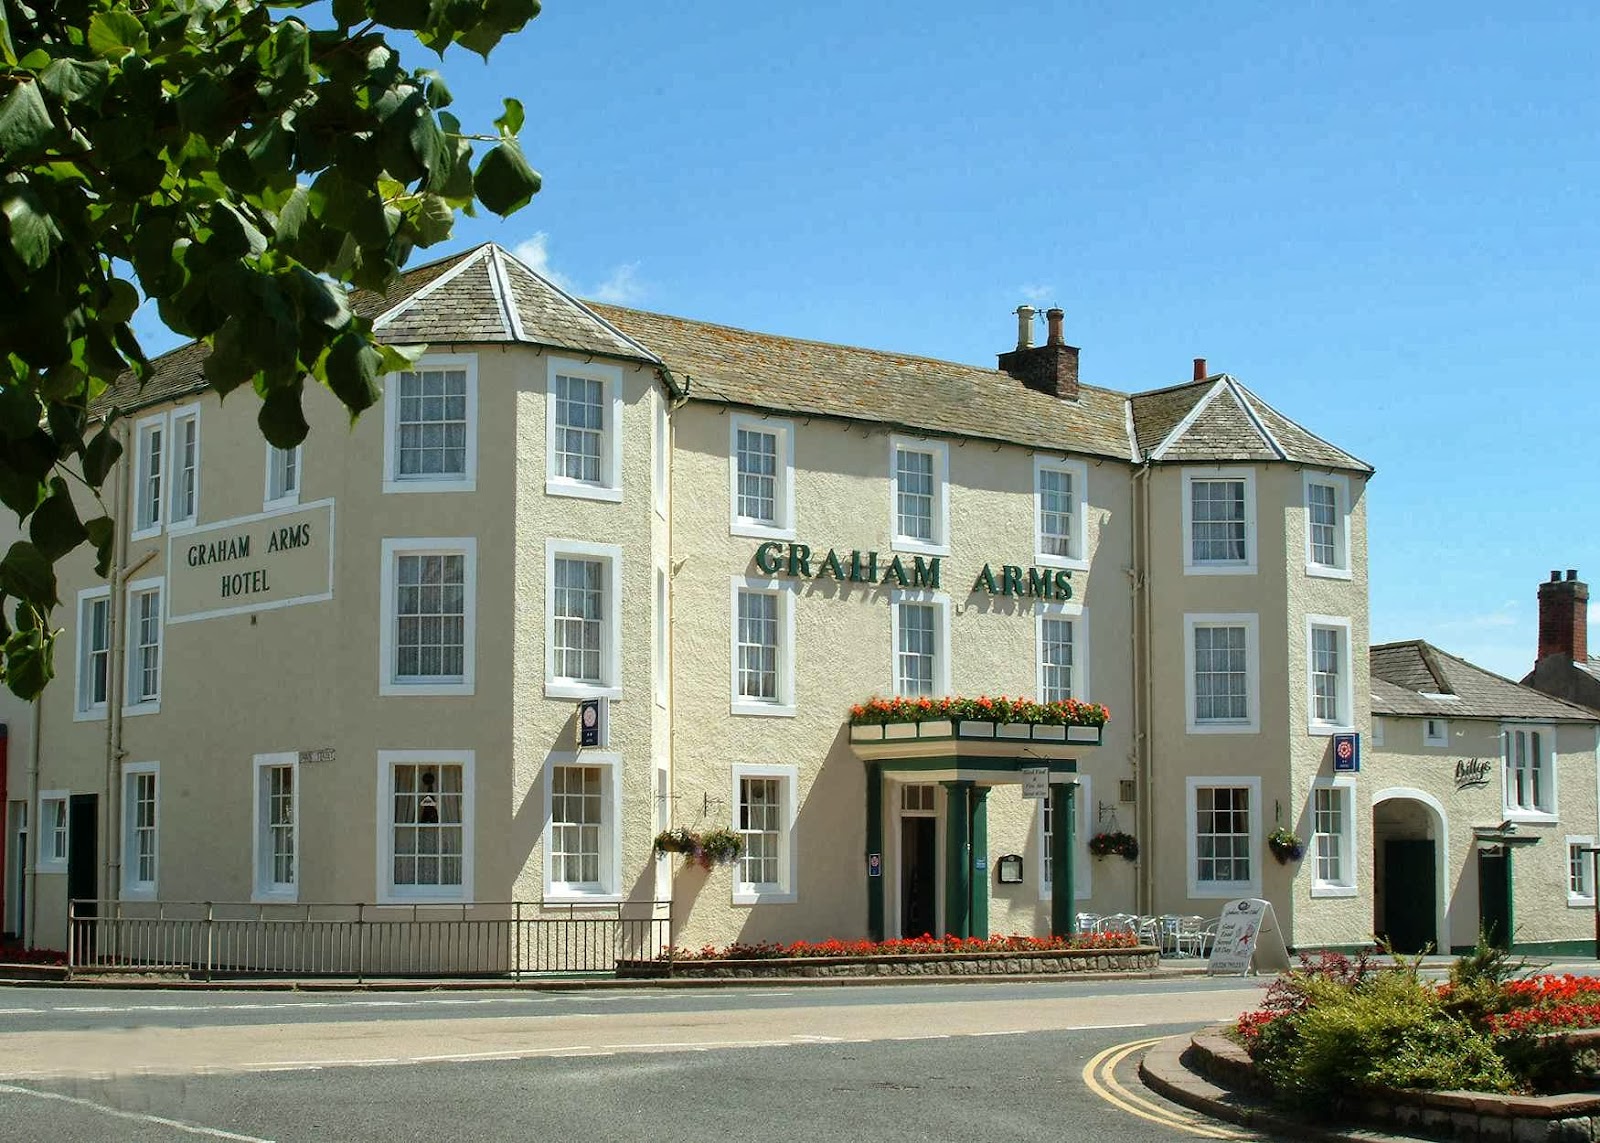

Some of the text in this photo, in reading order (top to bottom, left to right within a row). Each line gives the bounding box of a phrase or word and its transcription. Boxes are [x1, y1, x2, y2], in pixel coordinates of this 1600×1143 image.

[188, 523, 310, 567] GRAHAM ARMS
[221, 569, 270, 597] HOTEL
[755, 541, 1073, 601] GRAHAM ARMS
